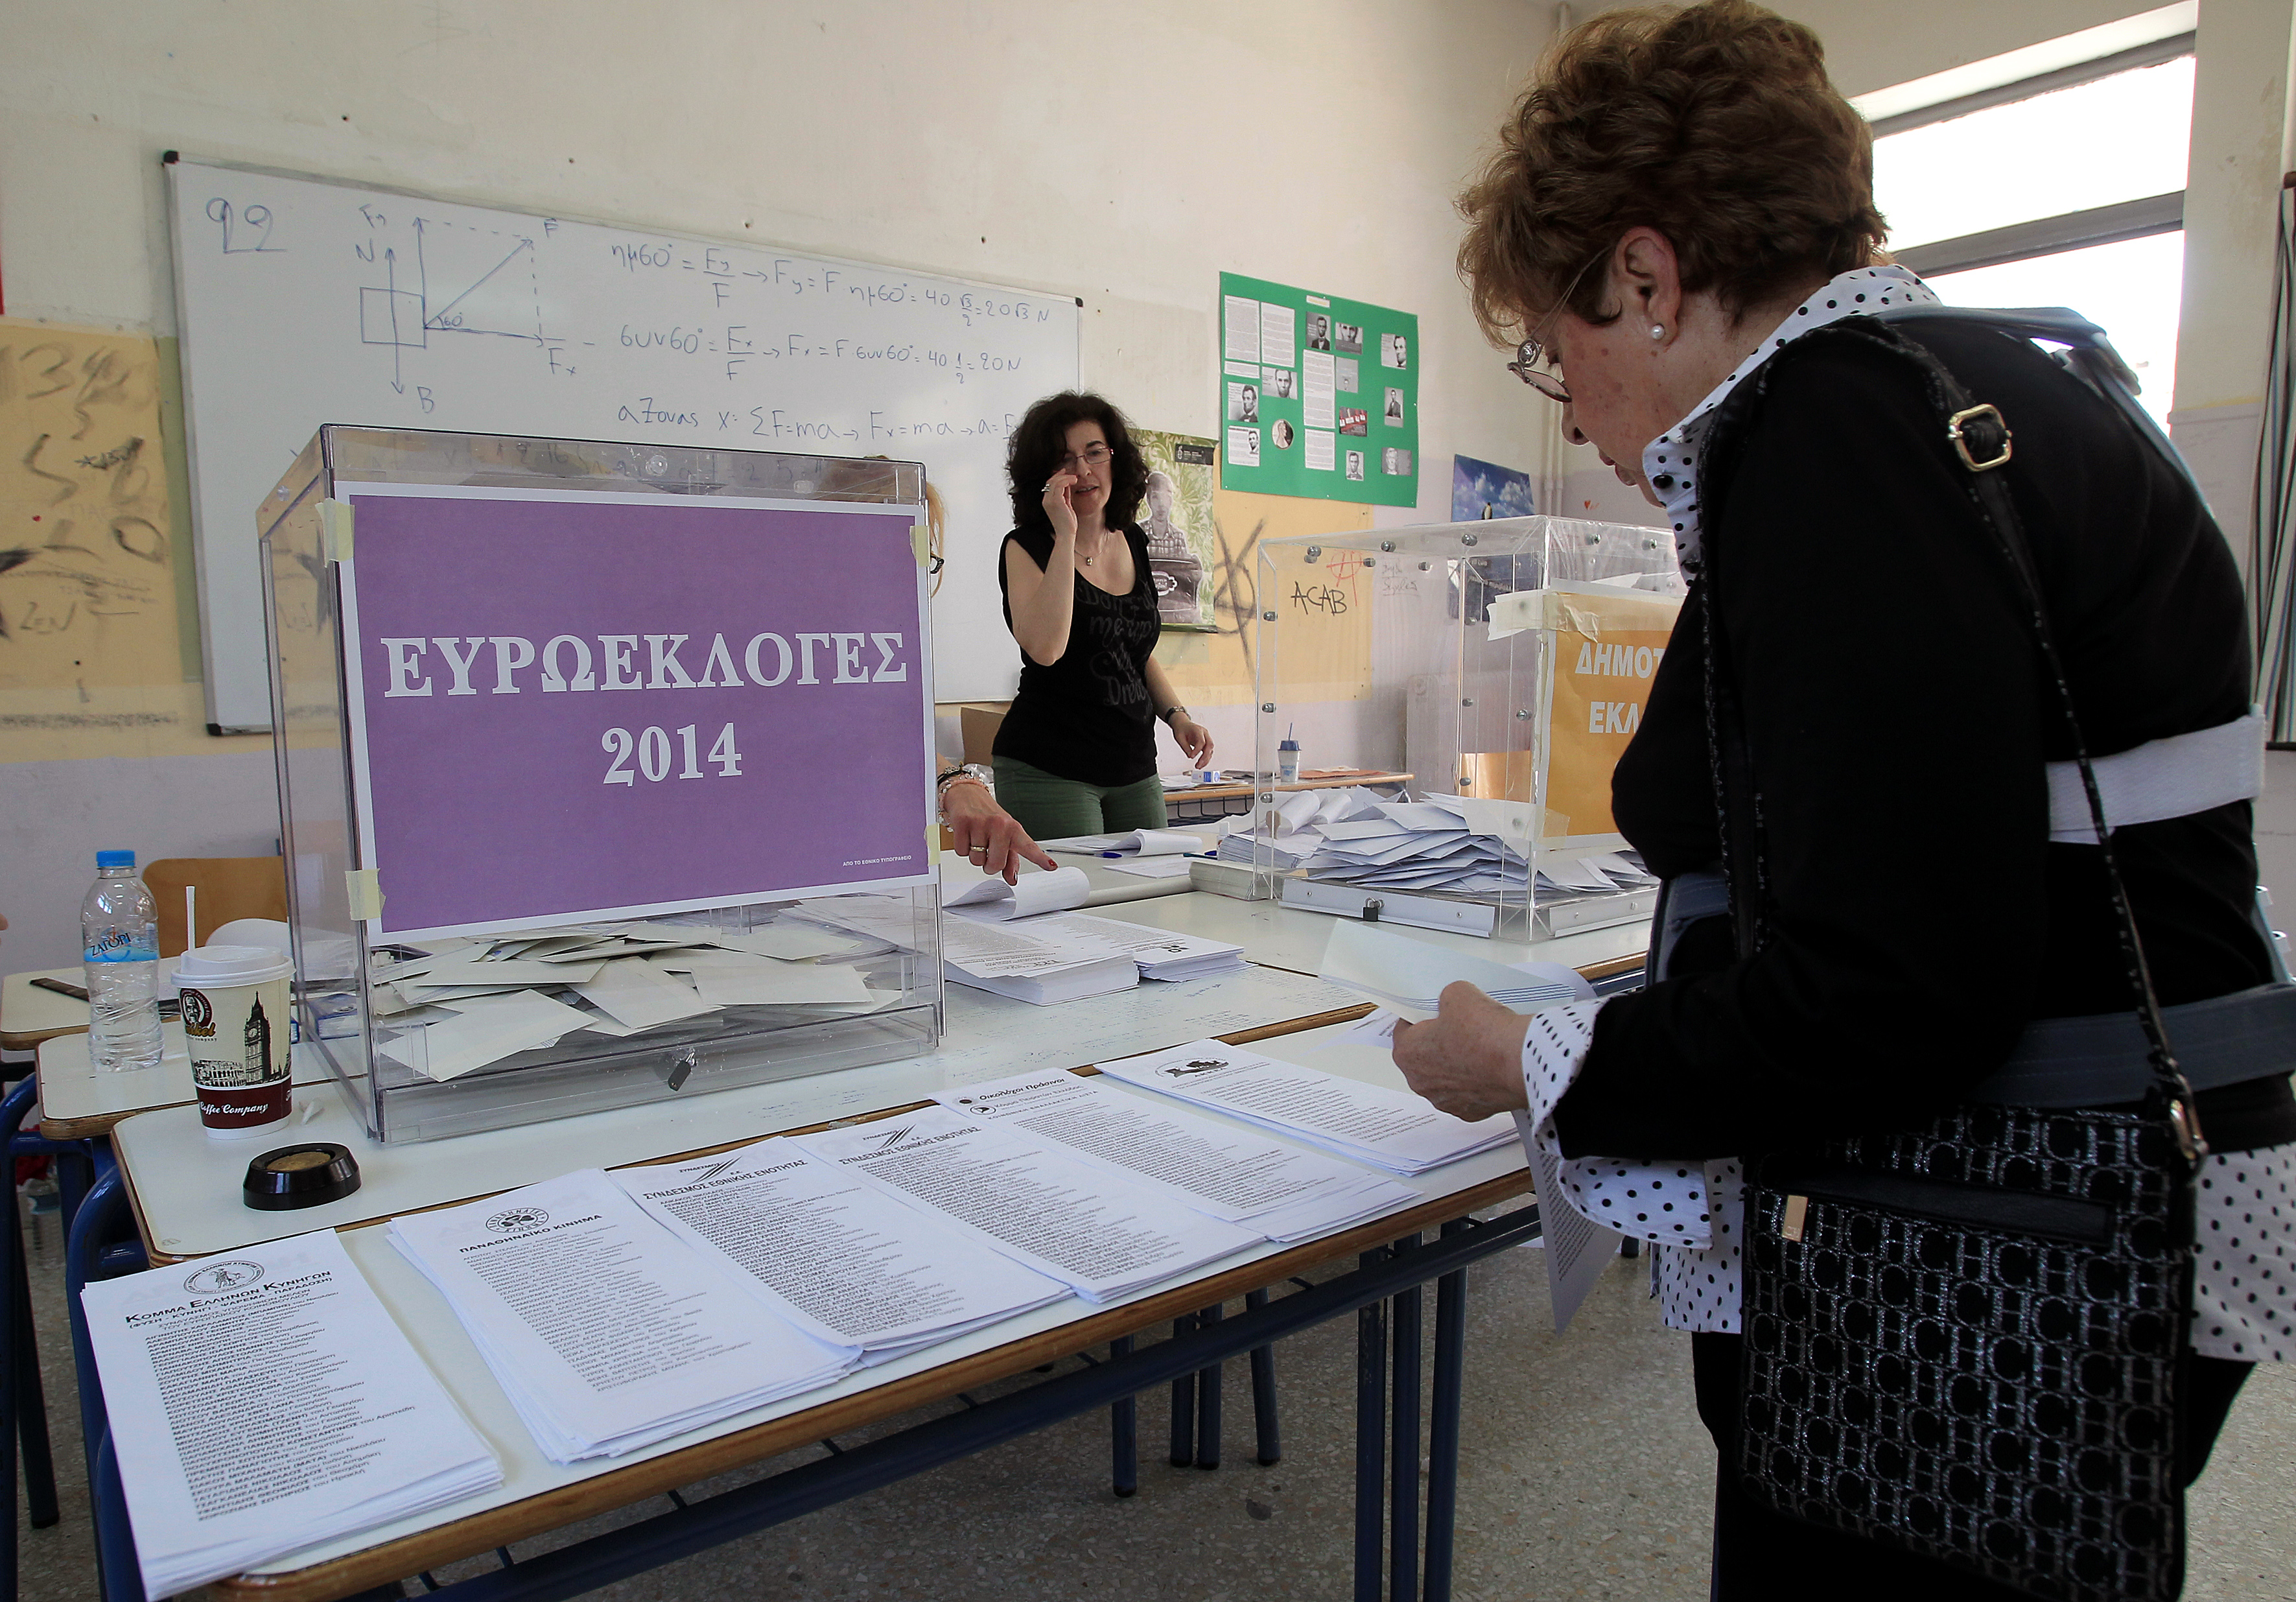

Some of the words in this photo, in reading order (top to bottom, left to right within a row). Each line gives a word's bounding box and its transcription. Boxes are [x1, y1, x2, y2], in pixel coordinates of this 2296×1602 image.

[1291, 581, 1347, 617] ACAB
[381, 631, 908, 698] ΕΥΡΩΕΚΛΟΓΕΣ
[1589, 701, 1646, 733] ΕΚΛ
[602, 722, 744, 787] 2014
[880, 854, 912, 863] ΤΥΠΟΓΡΑΦΕΙΟ
[91, 932, 132, 956] ΖΑΓΟΡΙ
[979, 1087, 1024, 1101] Οικολόγοι
[1025, 1078, 1065, 1091] Πράσινοι
[222, 1103, 269, 1116] Company
[836, 1148, 898, 1165] ΣΥΝΔΕΣΜΟΣ
[891, 1138, 938, 1151] ΕΘΝΙΚΗΣ
[930, 1126, 983, 1142] ΕΝΟΤΗΤΑΣ
[643, 1183, 710, 1199] ΣΥΝΔΕΣΜΟΣ
[709, 1173, 755, 1188] ΕΘΝΙΚΗΣ
[756, 1159, 808, 1177] ΕΝΟΤΗΤΑΣ
[458, 1227, 552, 1253] ΠΑΝΑΘΗΝΑΪΚΟ
[550, 1214, 604, 1230] ΚΙΝΗΜΑ
[125, 1304, 185, 1323] ΚΟΜΜΑ
[189, 1286, 260, 1308] ΕΛΛΗΝΩΝ
[262, 1270, 331, 1291] ΚΥΝΗΓΩΝ
[172, 1306, 211, 1319] ΚΥΝΗΓΙ
[220, 1293, 266, 1307] ΨΑΡΕΜΑ
[278, 1288, 310, 1299] ΜΕΛΩΝ
[191, 1314, 244, 1329] ΧΑΡΑΛΑΜΠΟΣ
[205, 1322, 245, 1334] ΓΕΩΡΓΙΟΣ
[210, 1317, 250, 1329] ΔΗΜΗΤΡΑ
[218, 1336, 258, 1348] ΓΕΩΡΓΙΟΣ
